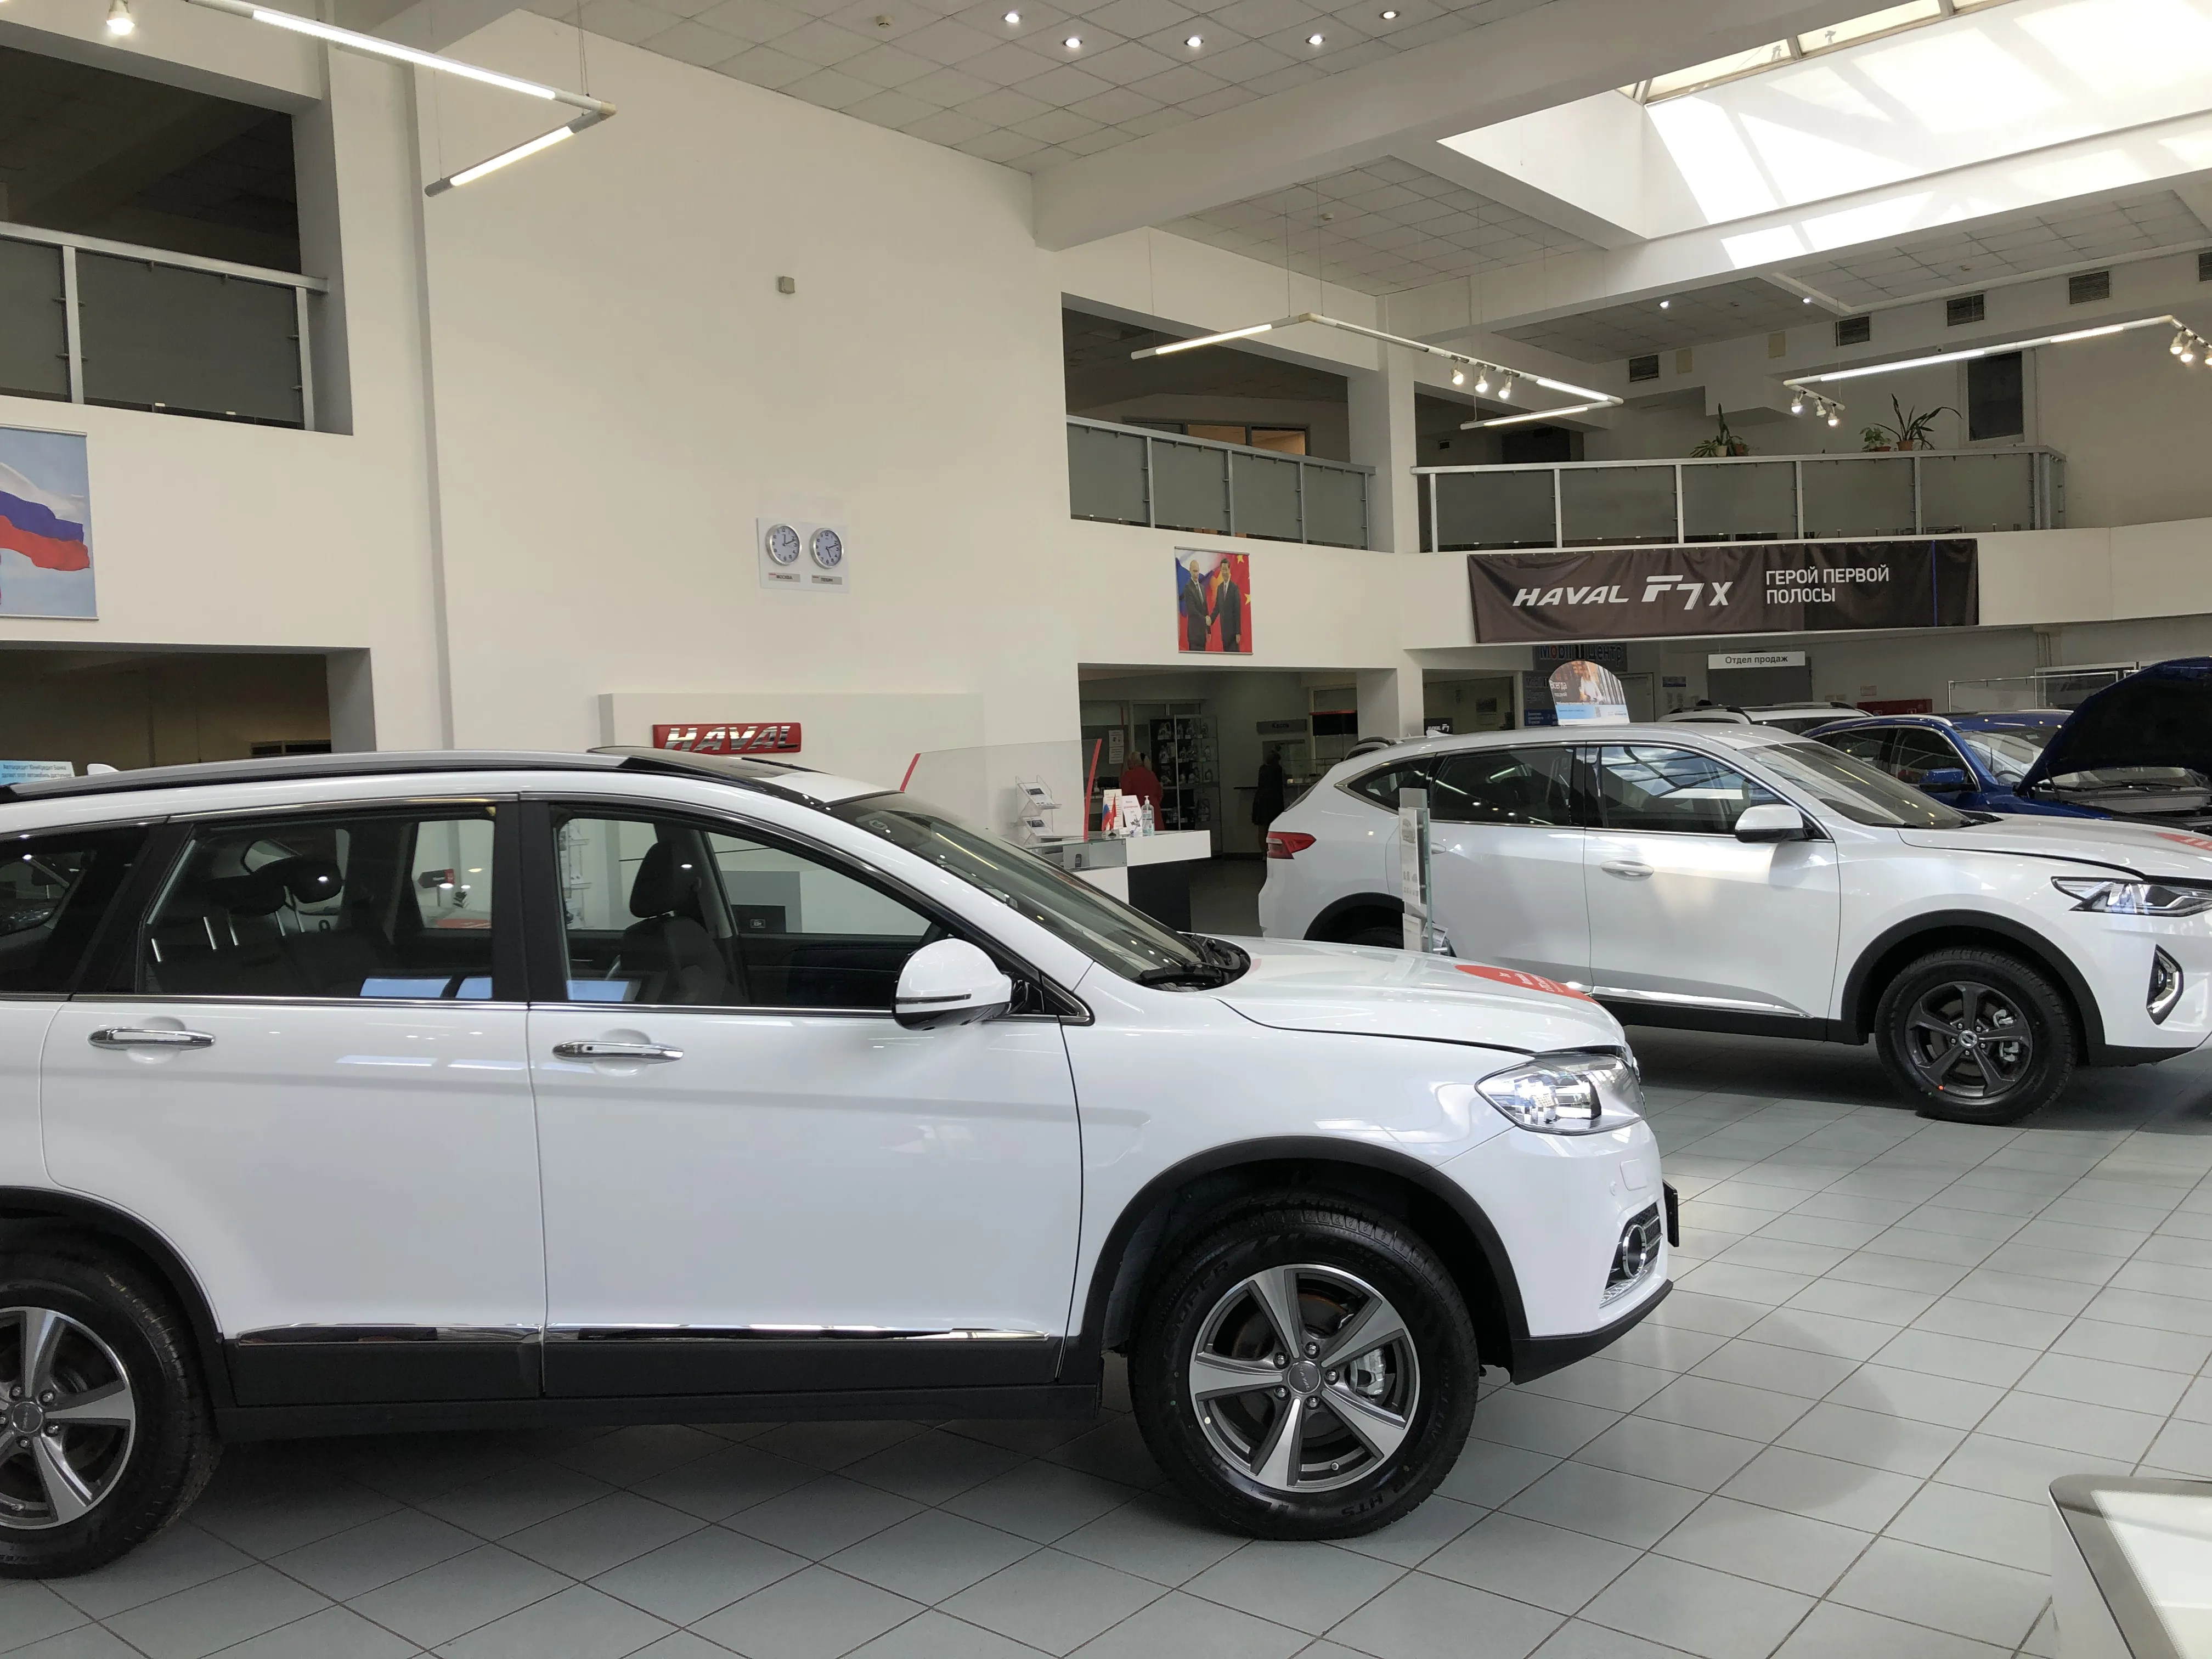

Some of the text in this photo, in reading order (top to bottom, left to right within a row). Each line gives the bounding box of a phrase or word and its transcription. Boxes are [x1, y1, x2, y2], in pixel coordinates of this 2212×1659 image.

[1766, 564, 1889, 585] ГЕРОЙ ПЕРВОЙ
[1513, 584, 1629, 606] HAVAL
[1767, 588, 1836, 604] ПОЛОСЫ
[1725, 656, 1788, 665] Отдел продаж
[1549, 680, 1567, 690] Всегда
[664, 726, 799, 752] HAVAL
